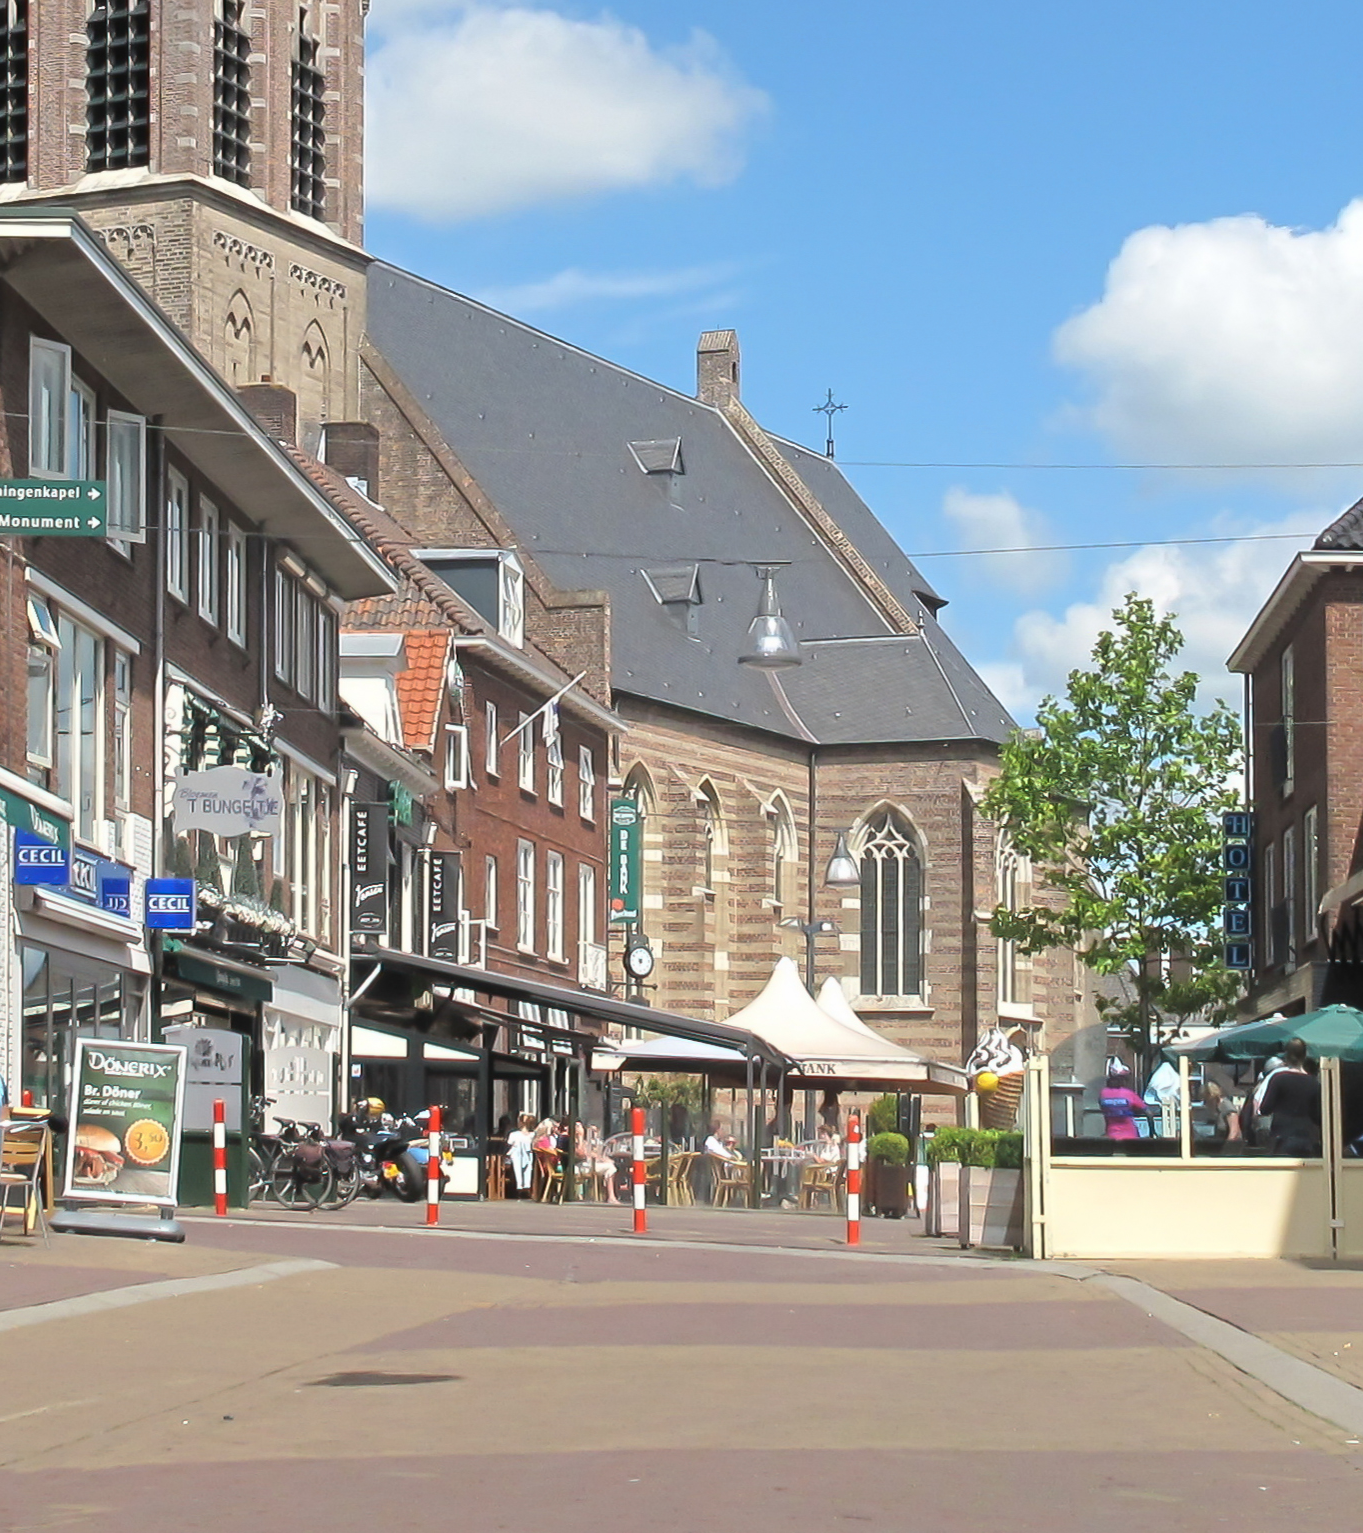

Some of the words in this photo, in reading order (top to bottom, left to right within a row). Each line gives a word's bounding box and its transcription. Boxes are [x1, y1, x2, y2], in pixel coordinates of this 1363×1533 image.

[18, 849, 66, 863] CECIL
[1225, 816, 1248, 965] HOTEL
[148, 897, 190, 910] CECIL
[84, 1084, 100, 1097] Br.
[102, 1085, 142, 1099] Döner
